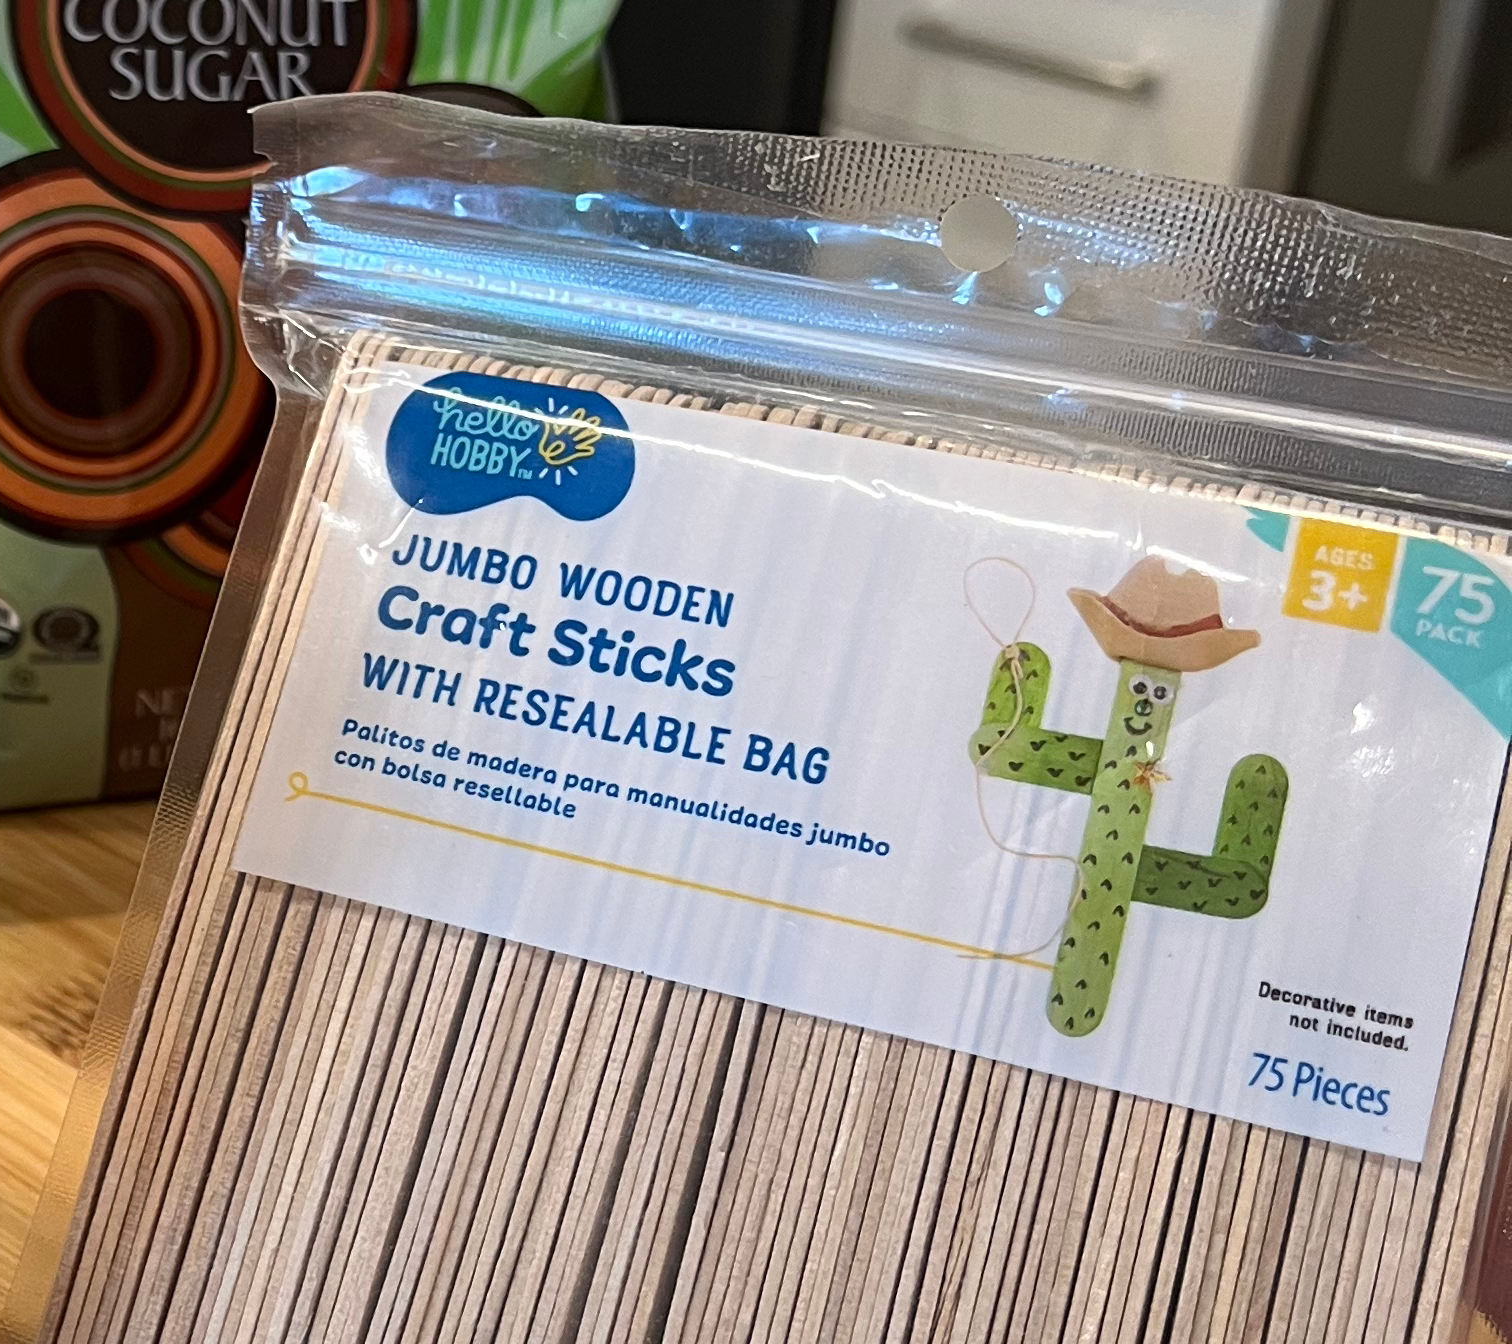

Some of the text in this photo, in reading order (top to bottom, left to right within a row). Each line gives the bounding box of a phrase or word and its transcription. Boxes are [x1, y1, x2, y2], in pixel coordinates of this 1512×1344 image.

[109, 48, 313, 102] SUGAR
[433, 387, 540, 442] hello
[392, 534, 734, 627] JUMBO WOODEN
[1314, 545, 1374, 570] AGES
[1302, 570, 1369, 612] 3+
[1417, 565, 1496, 626] 75
[377, 585, 736, 696] Craft Sticks
[1415, 618, 1482, 648] PACK
[362, 652, 830, 784] WITH RESEALABLE BAG
[334, 750, 576, 818] con bolsa resellable
[342, 719, 889, 855] Palitos de madera para manualidades jumbo
[1258, 981, 1414, 1029] Decorative items
[1289, 1014, 1409, 1051] not included.
[1248, 1052, 1390, 1116] 75 Pieces
